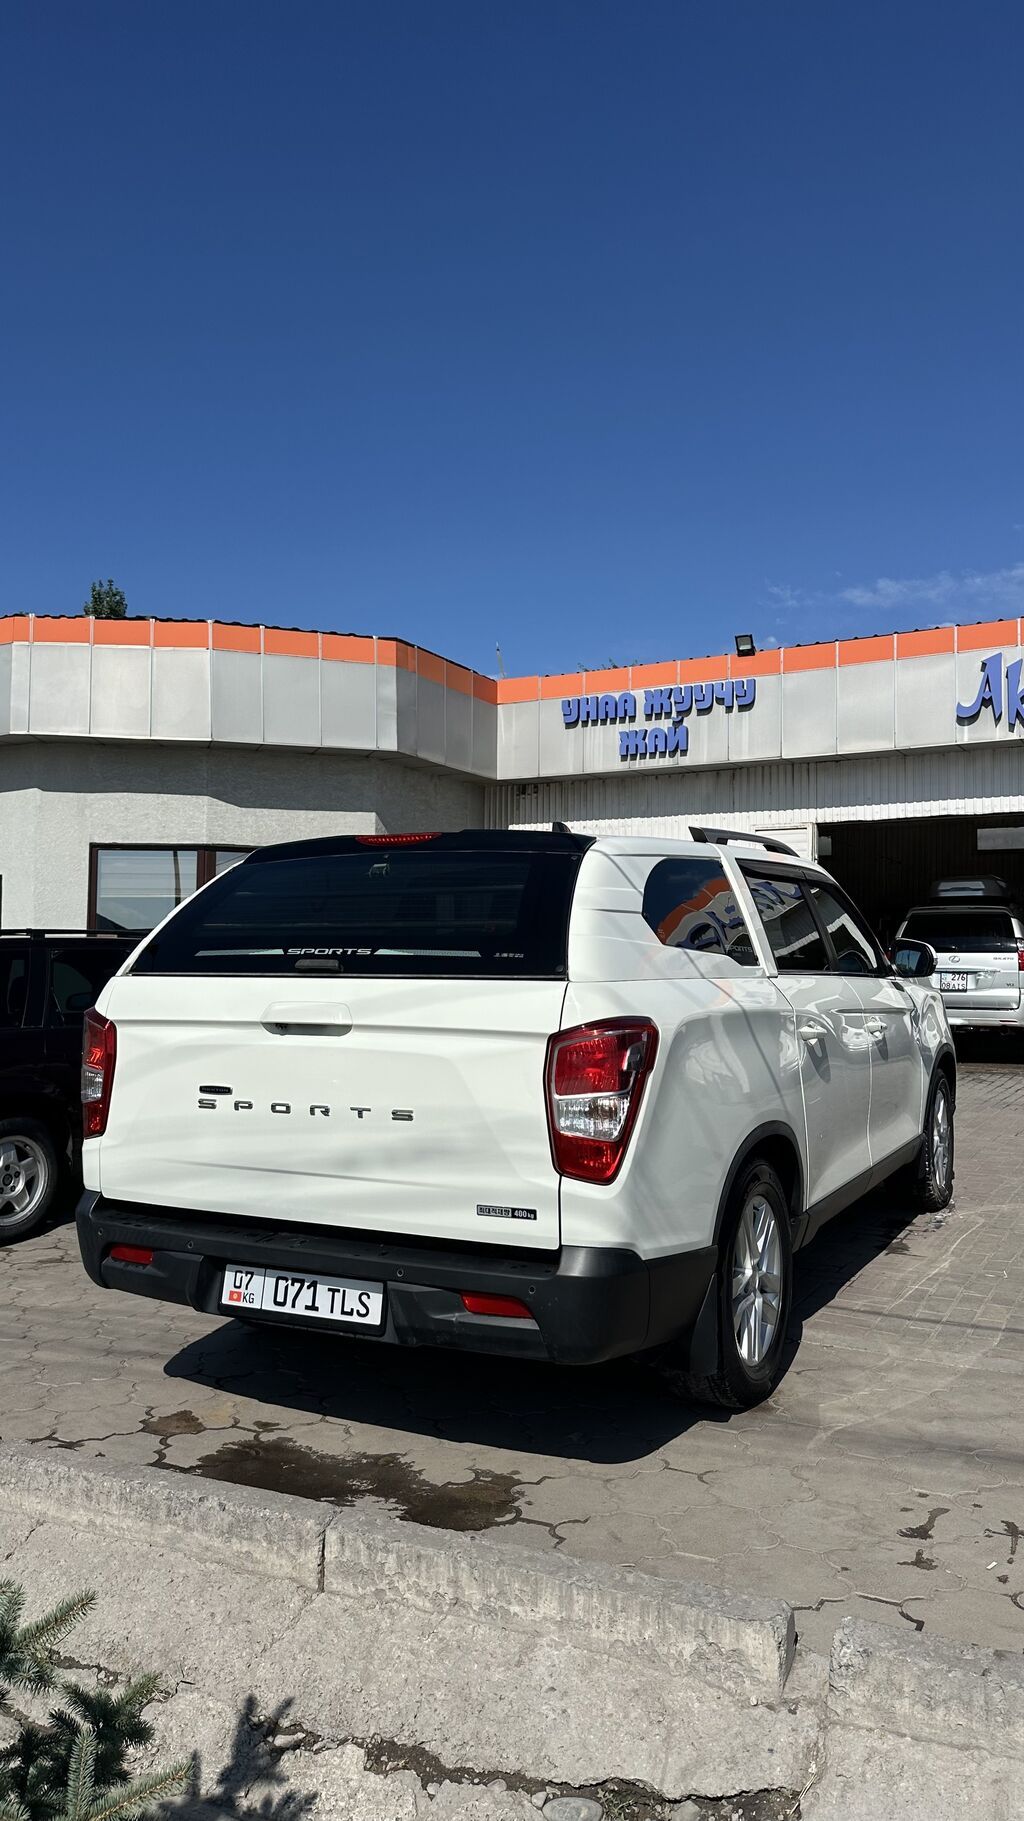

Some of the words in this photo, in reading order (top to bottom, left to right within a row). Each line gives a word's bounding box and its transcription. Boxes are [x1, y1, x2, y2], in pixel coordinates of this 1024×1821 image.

[561, 692, 636, 725] УНАА
[643, 678, 757, 716] ЖУУЧУ
[618, 715, 689, 757] ЖАЙ
[951, 973, 966, 981] 276
[198, 1098, 414, 1121] SPORTS
[513, 1209, 528, 1218] 400
[233, 1270, 255, 1291] 07
[242, 1292, 255, 1304] KG
[273, 1275, 319, 1312] 071
[327, 1287, 371, 1318] TLS
